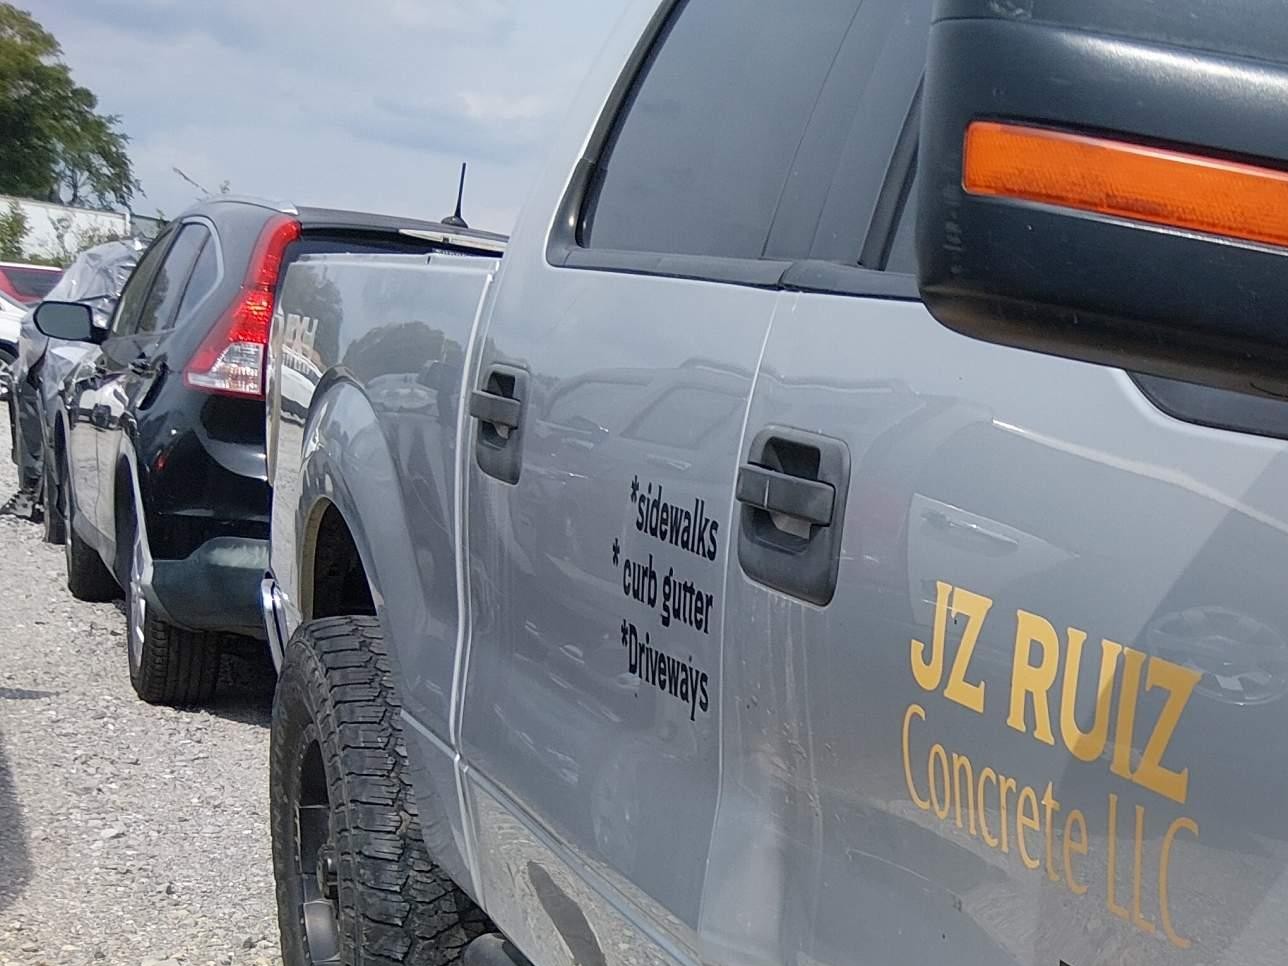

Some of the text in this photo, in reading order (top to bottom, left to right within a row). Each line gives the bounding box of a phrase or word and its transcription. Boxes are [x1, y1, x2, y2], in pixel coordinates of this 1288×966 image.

[623, 554, 657, 609] curb
[660, 566, 714, 634] gutter
[910, 580, 1202, 804] JZ RUIZ
[902, 703, 1200, 950] Concrete LLC
